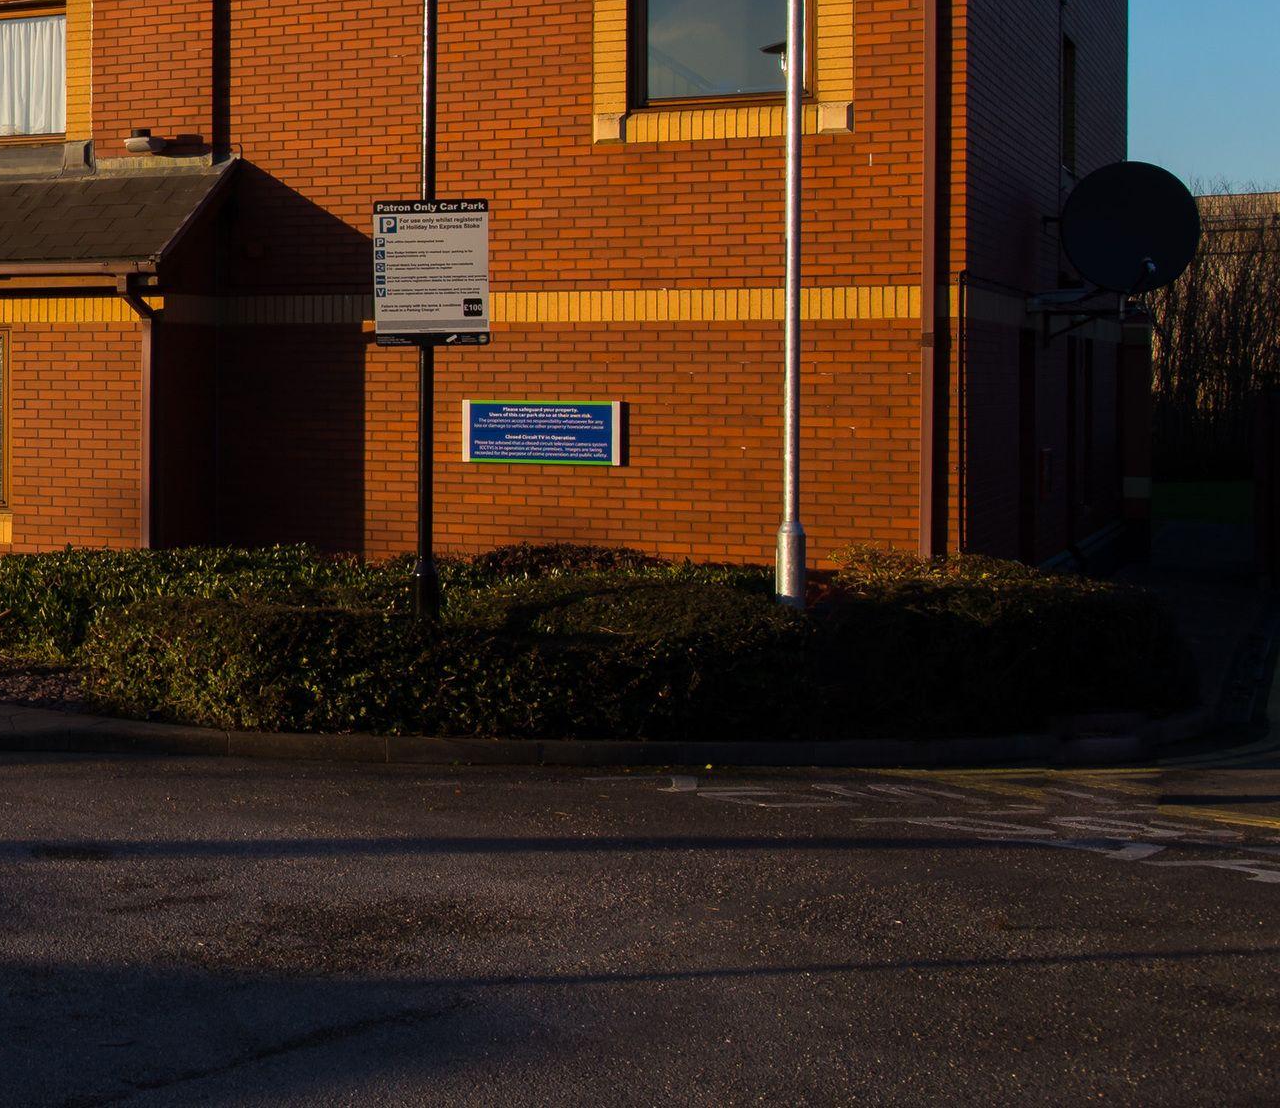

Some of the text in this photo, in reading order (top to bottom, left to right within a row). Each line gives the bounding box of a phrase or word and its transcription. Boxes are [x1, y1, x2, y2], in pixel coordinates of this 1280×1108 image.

[376, 202, 485, 213] Patron Only Car Park
[464, 303, 482, 312] £100
